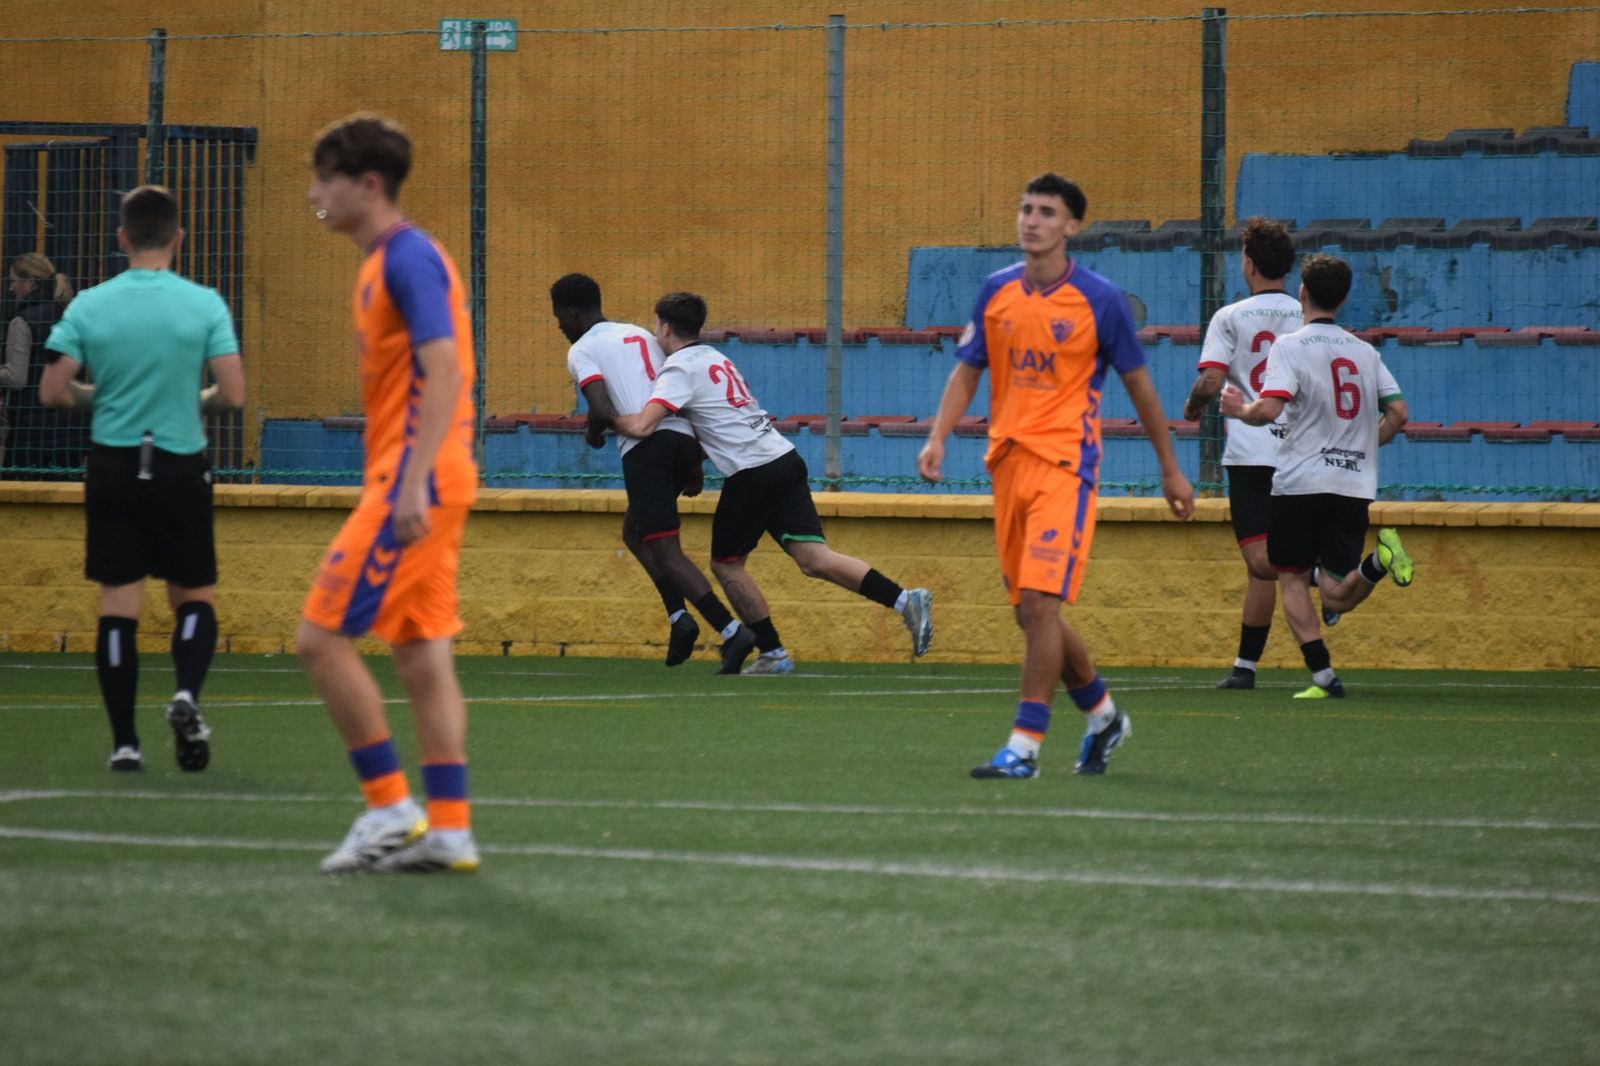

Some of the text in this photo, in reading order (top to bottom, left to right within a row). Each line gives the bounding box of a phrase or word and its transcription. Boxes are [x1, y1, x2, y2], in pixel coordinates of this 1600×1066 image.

[623, 335, 656, 382] 7
[1008, 348, 1057, 376] LAX
[1330, 357, 1361, 420] 6
